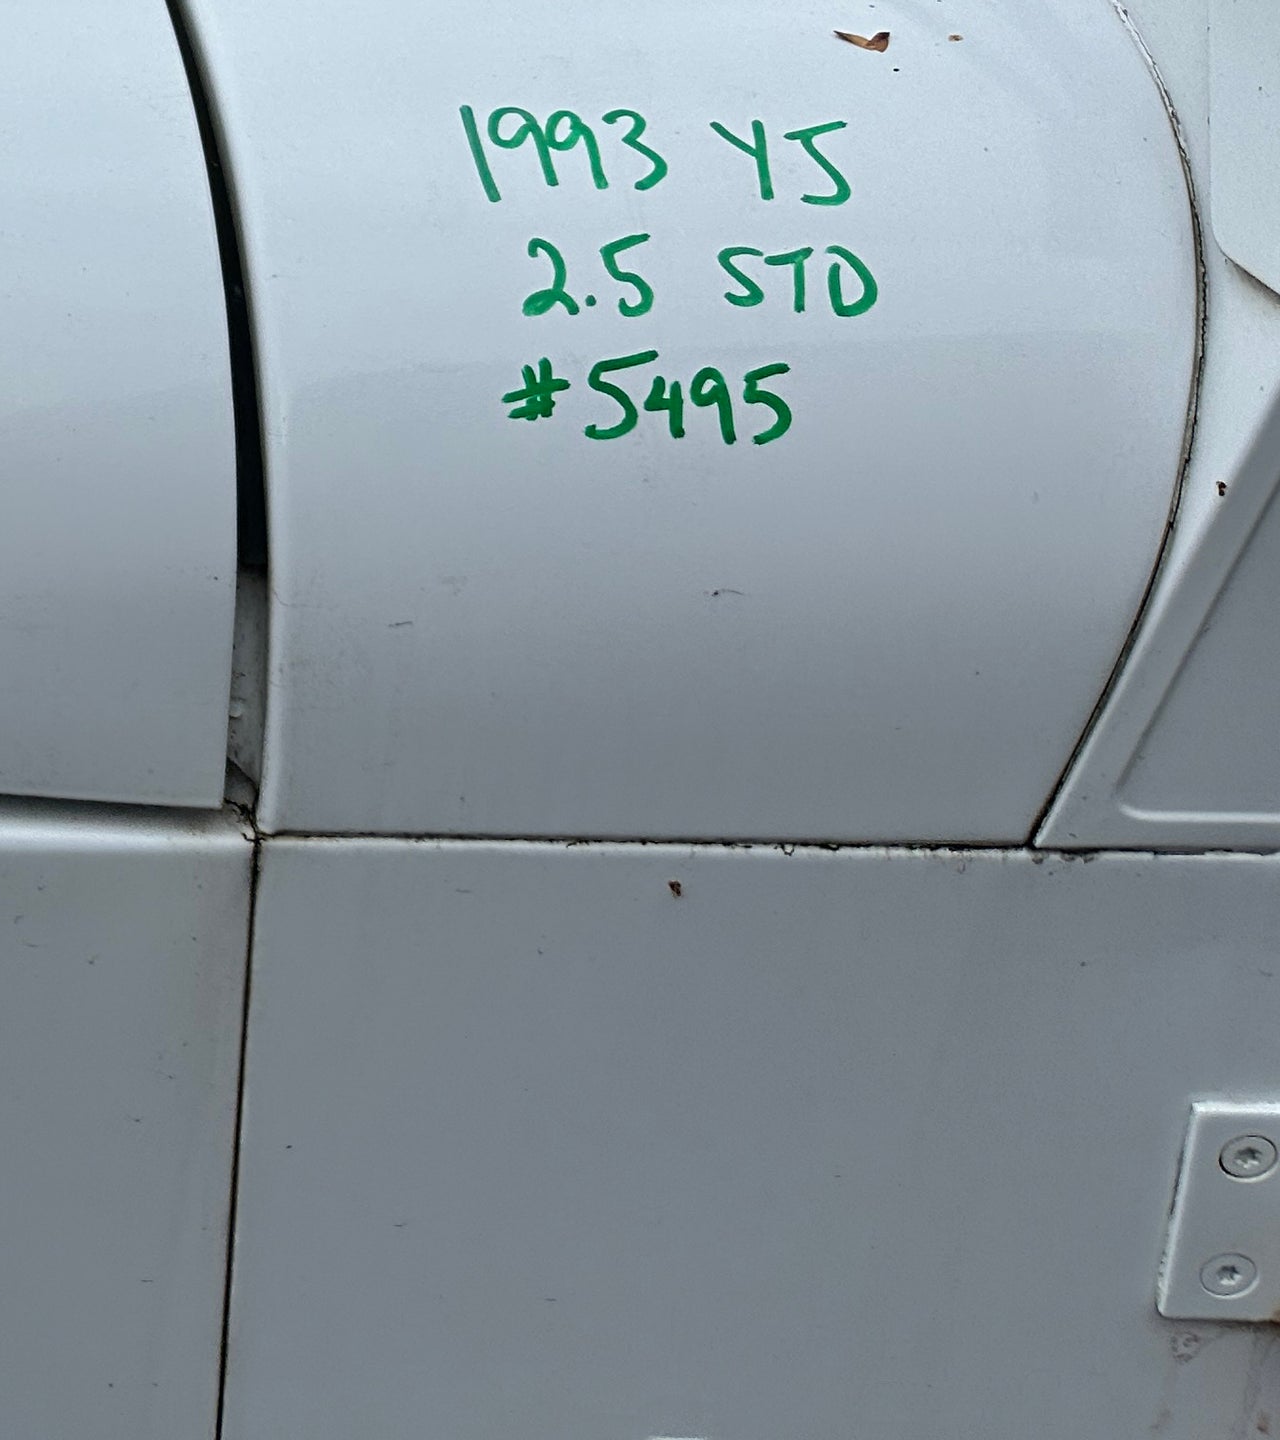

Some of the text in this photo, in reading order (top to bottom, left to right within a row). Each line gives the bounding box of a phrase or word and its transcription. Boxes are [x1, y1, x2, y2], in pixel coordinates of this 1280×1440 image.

[459, 104, 852, 206] 1993 YJ
[521, 232, 879, 318] 2.5 STD
[501, 349, 793, 446] #5495
